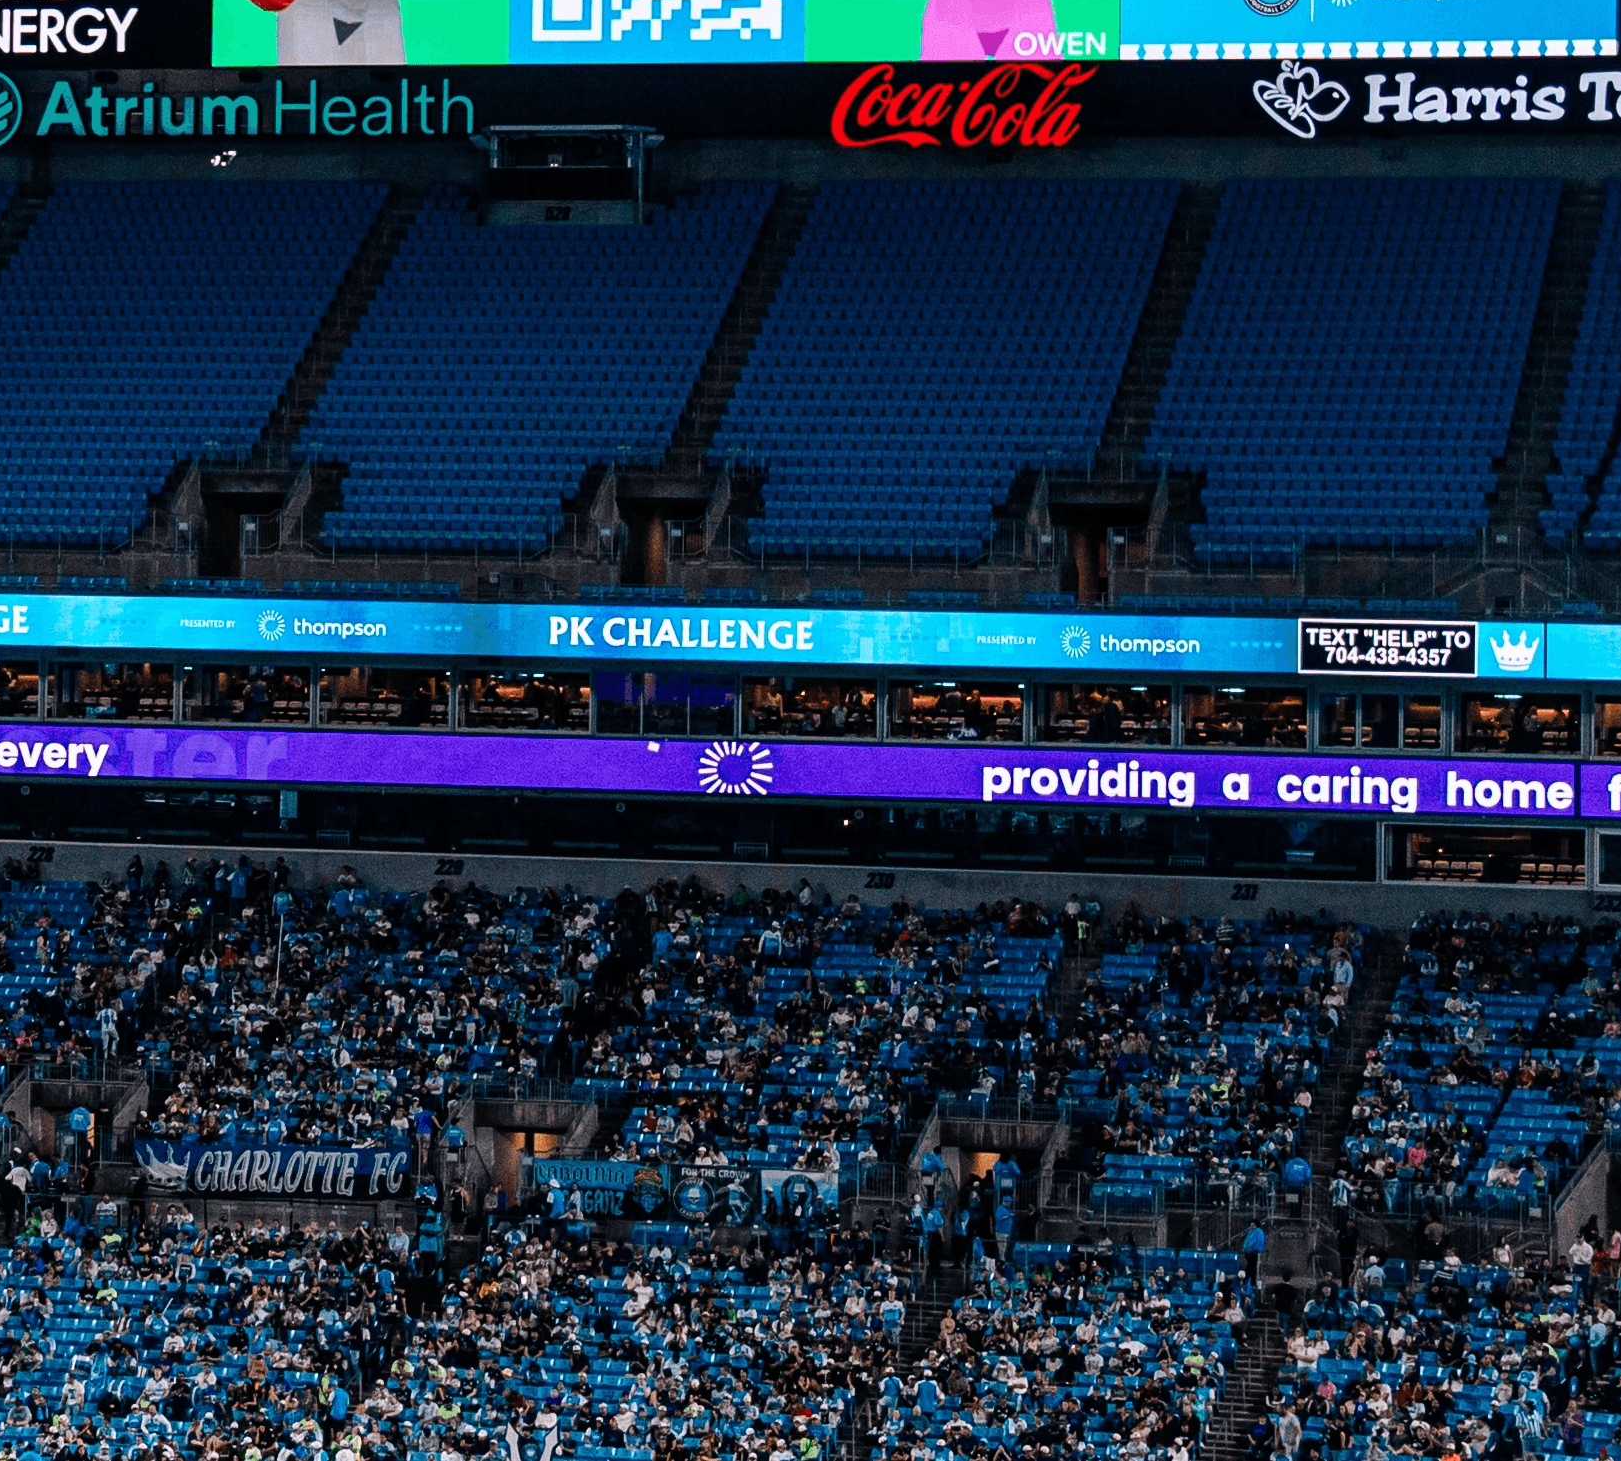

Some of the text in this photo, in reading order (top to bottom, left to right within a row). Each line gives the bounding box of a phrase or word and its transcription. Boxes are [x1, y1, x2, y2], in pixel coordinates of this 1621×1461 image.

[1014, 33, 1106, 56] OWEN
[37, 79, 473, 135] Atrium Health
[1364, 73, 1565, 122] Harris
[295, 619, 385, 638] thompson
[550, 617, 813, 649] PK CHALLENGE
[1306, 628, 1470, 651] TEXT "HELP" TO
[1101, 635, 1199, 655] thompson
[1325, 646, 1452, 666] 704-438-4357
[983, 759, 1195, 807] providing
[1223, 773, 1249, 800] a
[1278, 766, 1417, 813] caring
[1447, 771, 1573, 809] home
[864, 872, 894, 889] 230
[1230, 884, 1258, 900] 231
[195, 1150, 407, 1196] CHARLOTTE FC
[682, 1168, 698, 1177] FOR
[701, 1169, 716, 1178] THE
